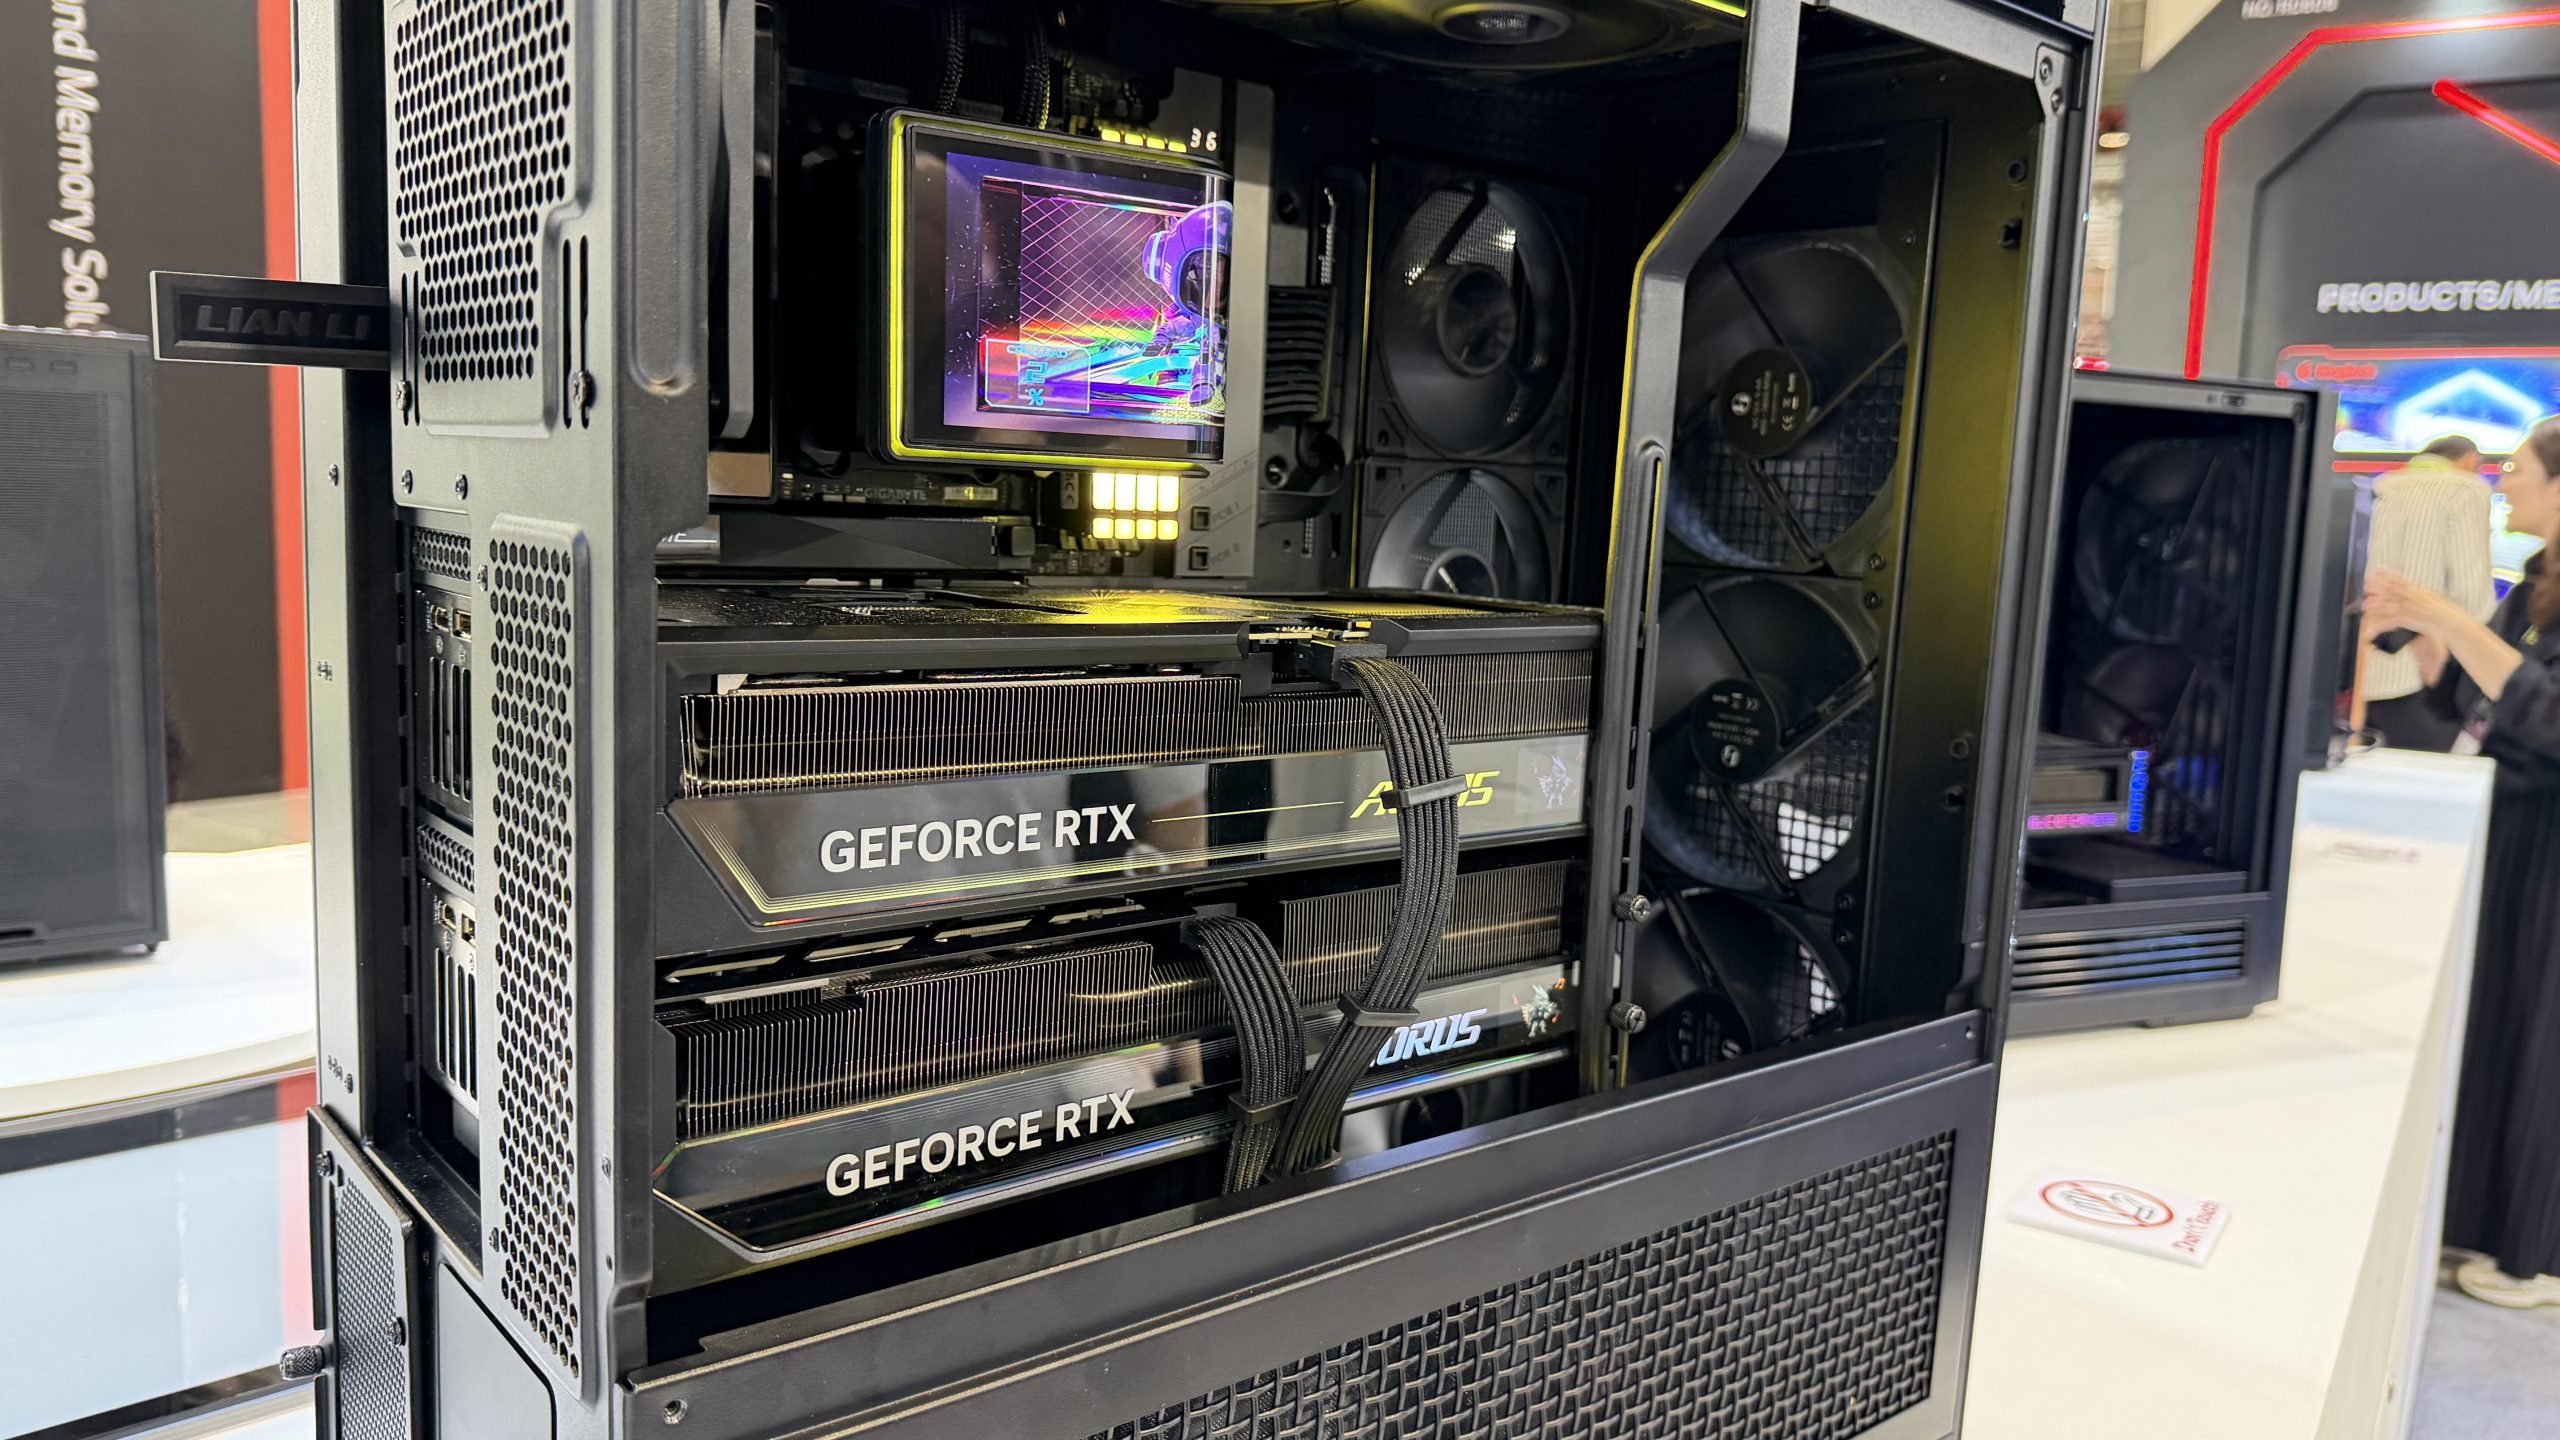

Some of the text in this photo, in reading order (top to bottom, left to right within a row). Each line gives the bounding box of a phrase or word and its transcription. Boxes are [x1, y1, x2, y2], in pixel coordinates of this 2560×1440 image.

[51, 0, 98, 62] nd
[47, 65, 100, 243] Memory
[197, 304, 372, 341] LIAN LI
[1024, 361, 1048, 384] 2
[821, 803, 1136, 873] GEFORCE RTX
[1369, 1008, 1488, 1068] ORUS
[826, 1088, 1135, 1197] GEFORCE RTX
